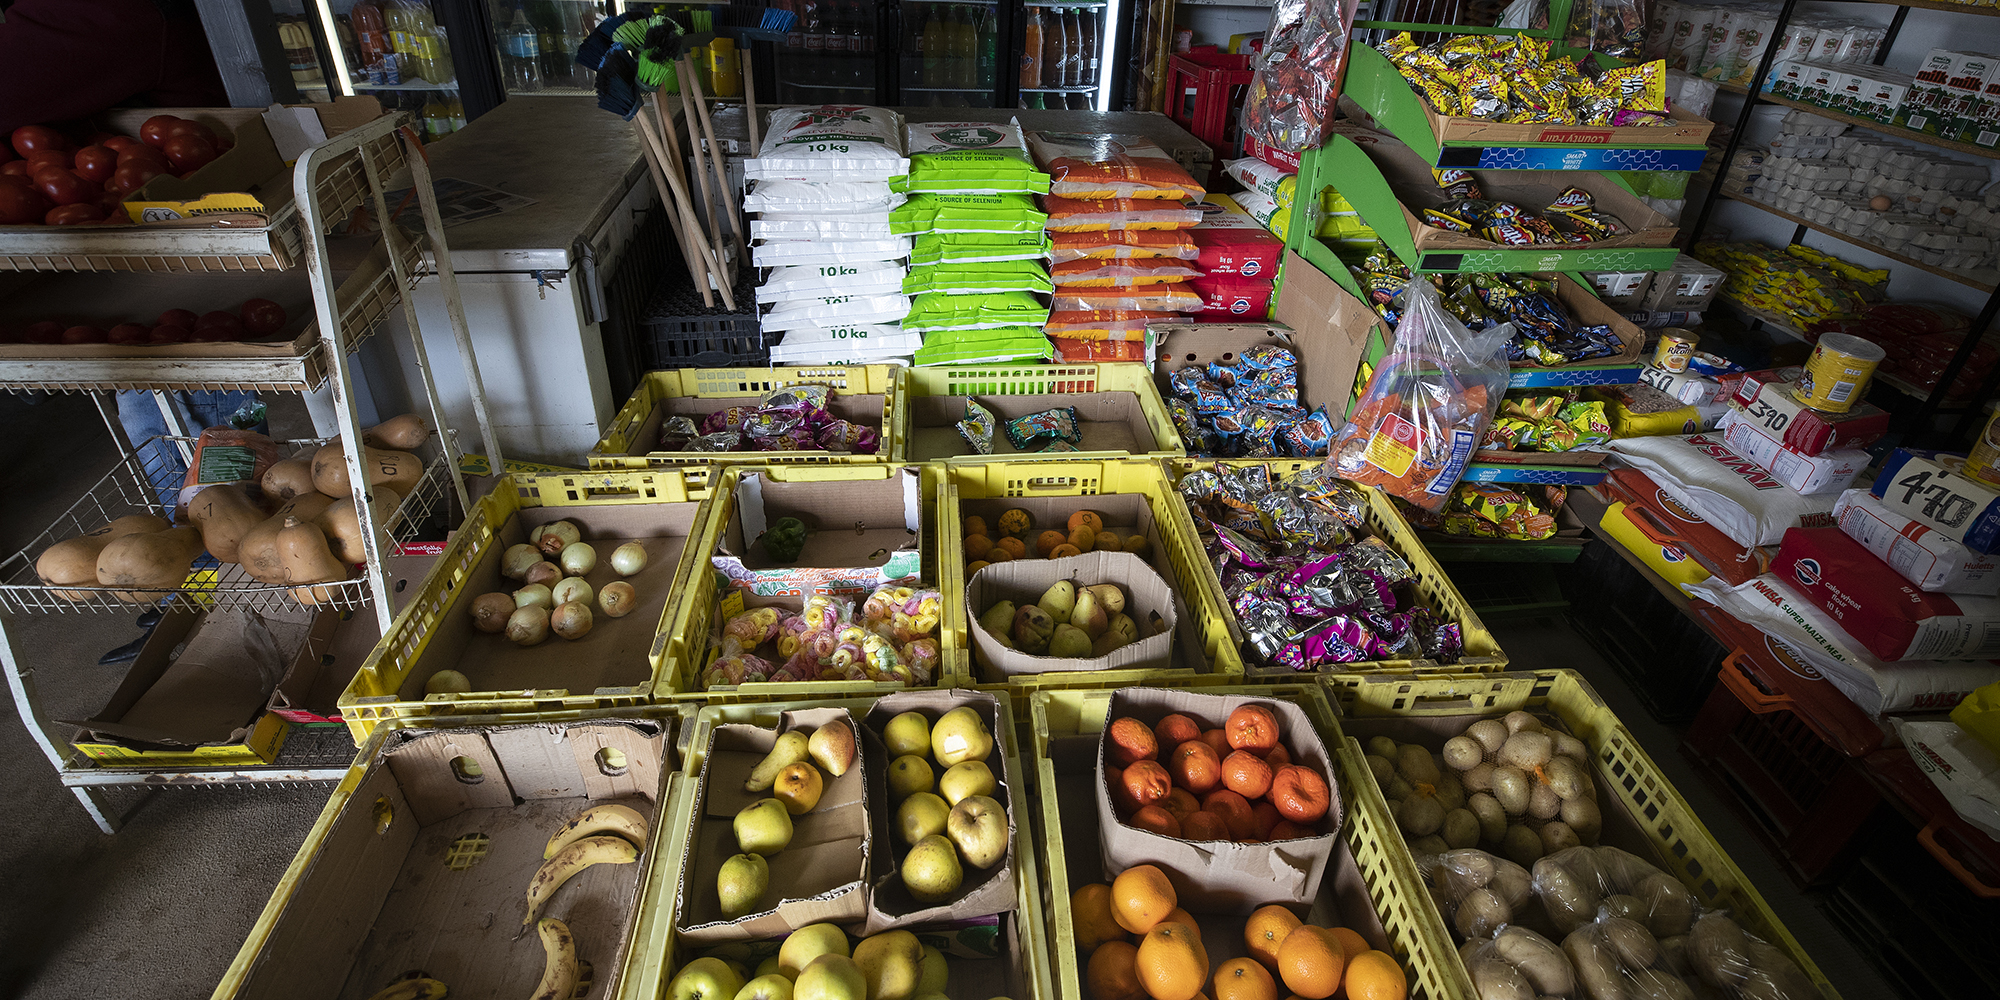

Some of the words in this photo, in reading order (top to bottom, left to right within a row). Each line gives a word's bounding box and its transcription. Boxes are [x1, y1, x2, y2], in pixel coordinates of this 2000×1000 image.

[1916, 70, 1949, 85] milk
[1948, 76, 1983, 92] milk
[808, 143, 827, 152] 10
[830, 143, 849, 153] kg
[819, 267, 837, 276] 10
[831, 329, 848, 339] 10
[1684, 433, 1784, 491] IWISA
[1963, 562, 1995, 570] Huletts
[776, 587, 864, 596] GRENTE
[1825, 582, 1841, 596] cake
[1840, 592, 1862, 611] wheat
[1900, 586, 1914, 594] 10
[1909, 593, 1921, 604] kg
[1831, 594, 1847, 608] flour
[1752, 580, 1784, 607] IWISA
[1781, 604, 1805, 626] SUPER
[1803, 623, 1825, 646] MAIZE
[1826, 600, 1835, 611] 10
[1834, 607, 1844, 620] kg
